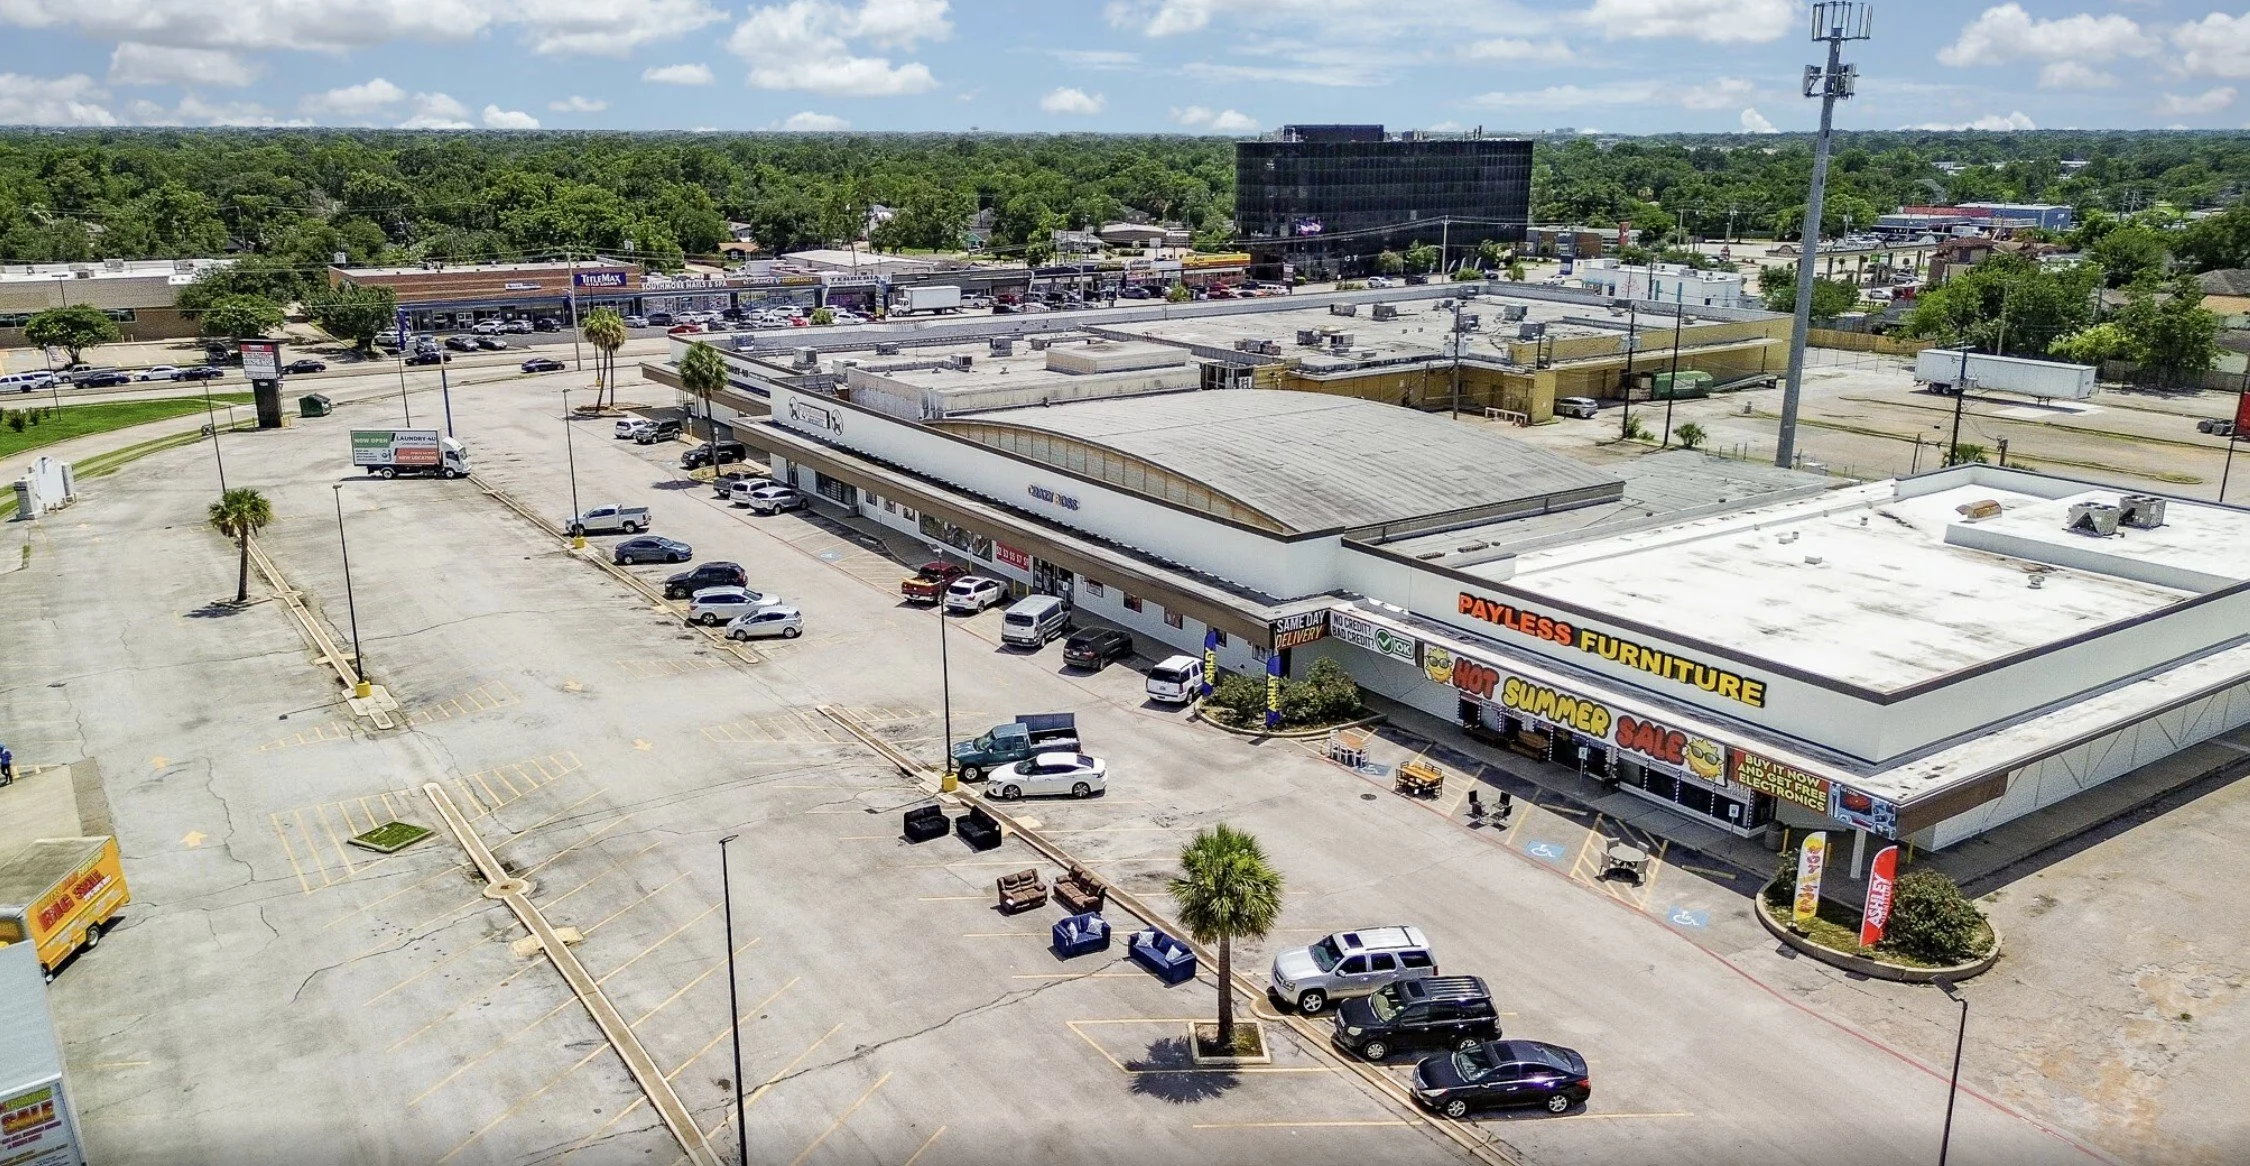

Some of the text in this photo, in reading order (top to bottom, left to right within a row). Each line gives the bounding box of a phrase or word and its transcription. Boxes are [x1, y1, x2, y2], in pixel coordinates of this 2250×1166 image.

[641, 281, 685, 291] SOUTHMORE
[686, 280, 706, 289] NAILS
[714, 280, 728, 288] SPA
[1053, 493, 1080, 511] BOSS
[1276, 610, 1326, 633] SAME DAY
[1276, 625, 1323, 648] DELIVERY
[1332, 625, 1346, 640] BAD
[1333, 613, 1343, 627] NO
[1396, 643, 1411, 655] OK
[1458, 592, 1767, 708] PAYLESS FURNITURE
[1204, 647, 1216, 686] ASHLEY
[1267, 673, 1277, 712] ASHLEY
[1453, 657, 1688, 766] HOT SUMMER SALE
[1737, 763, 1764, 778] AND
[1766, 772, 1793, 789] GET
[1794, 782, 1827, 803] FREE
[1745, 754, 1821, 788] BUY IT NOW
[1738, 772, 1826, 812] ELECTRONICS
[1867, 872, 1887, 929] ASHLEY
